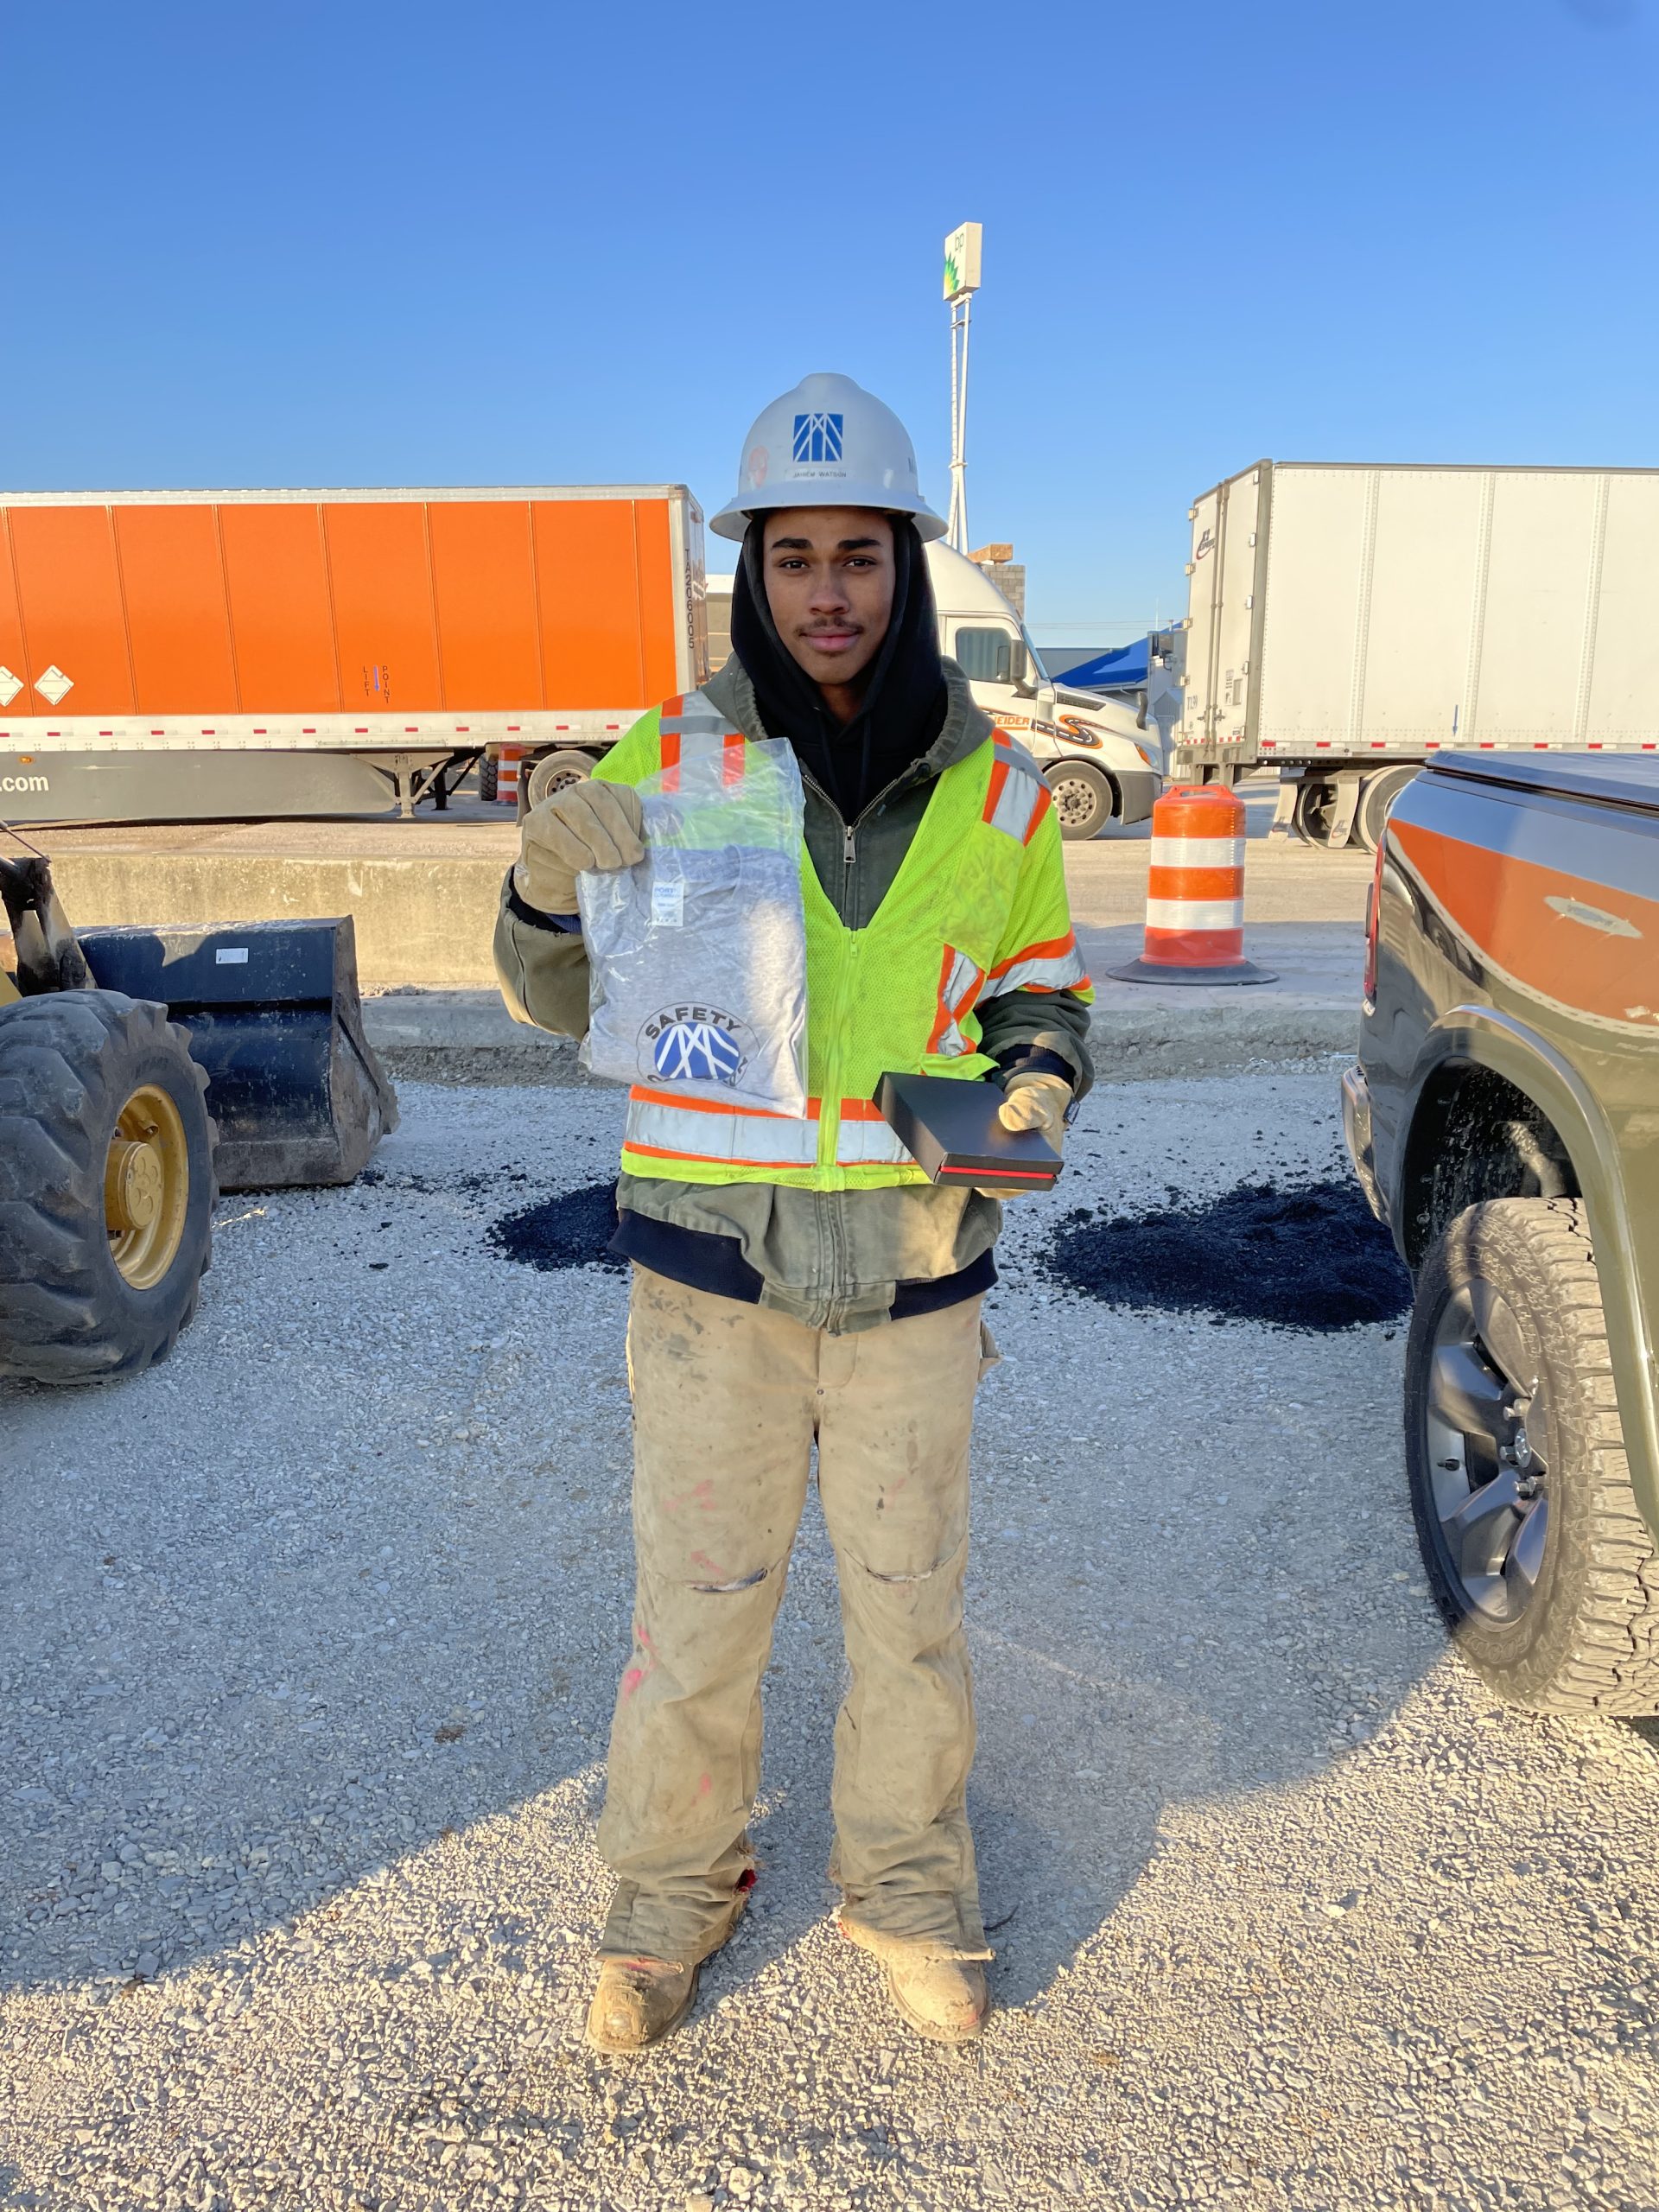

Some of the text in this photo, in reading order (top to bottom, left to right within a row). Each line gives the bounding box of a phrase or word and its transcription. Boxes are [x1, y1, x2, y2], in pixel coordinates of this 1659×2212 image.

[954, 232, 964, 252] bp
[684, 549, 695, 649] TA206005
[382, 664, 391, 704] POINT
[995, 715, 1030, 726] EIDER
[645, 1006, 742, 1040] SAFETY
